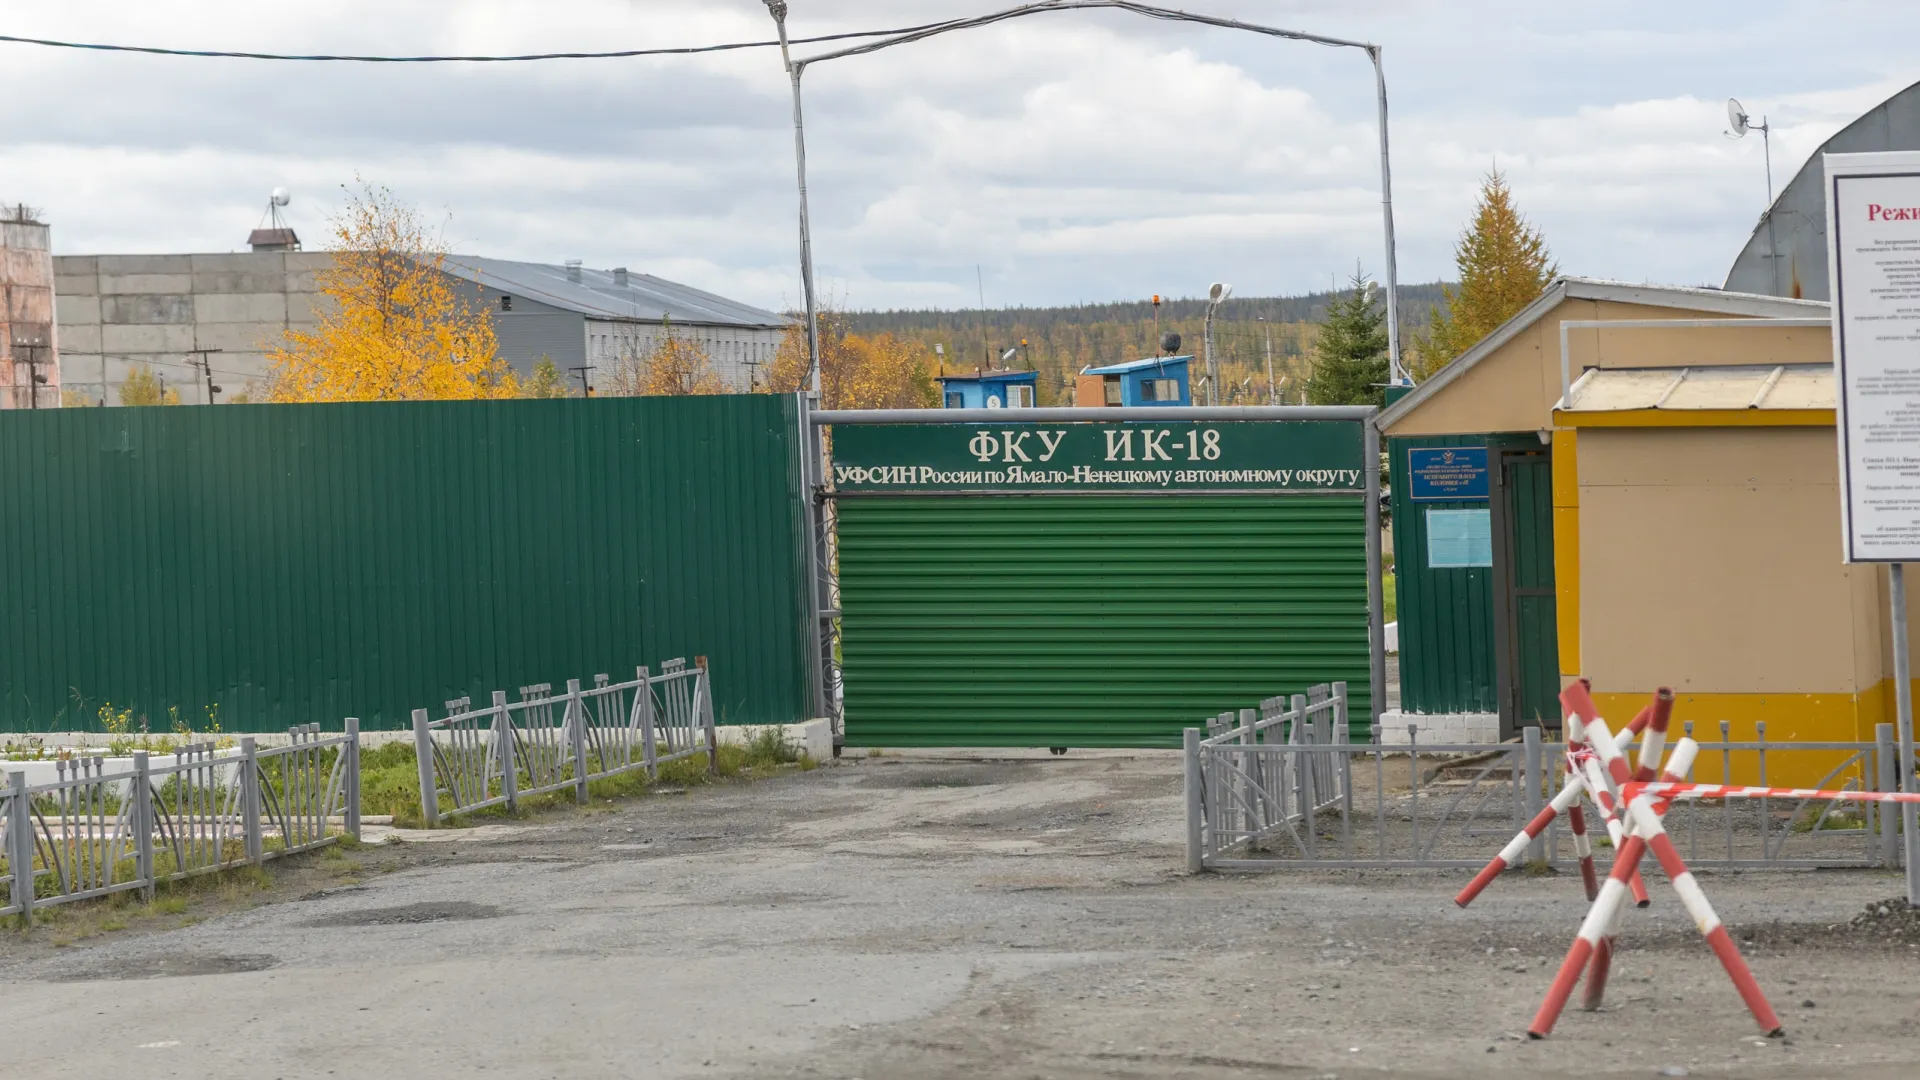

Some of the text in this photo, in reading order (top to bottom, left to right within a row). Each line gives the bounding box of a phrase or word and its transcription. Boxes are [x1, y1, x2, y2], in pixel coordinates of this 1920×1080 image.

[969, 429, 1221, 462] ФКУ ИК-18
[835, 466, 1362, 487] УФСИН России по Ямало-Ненецкому автономному округу
